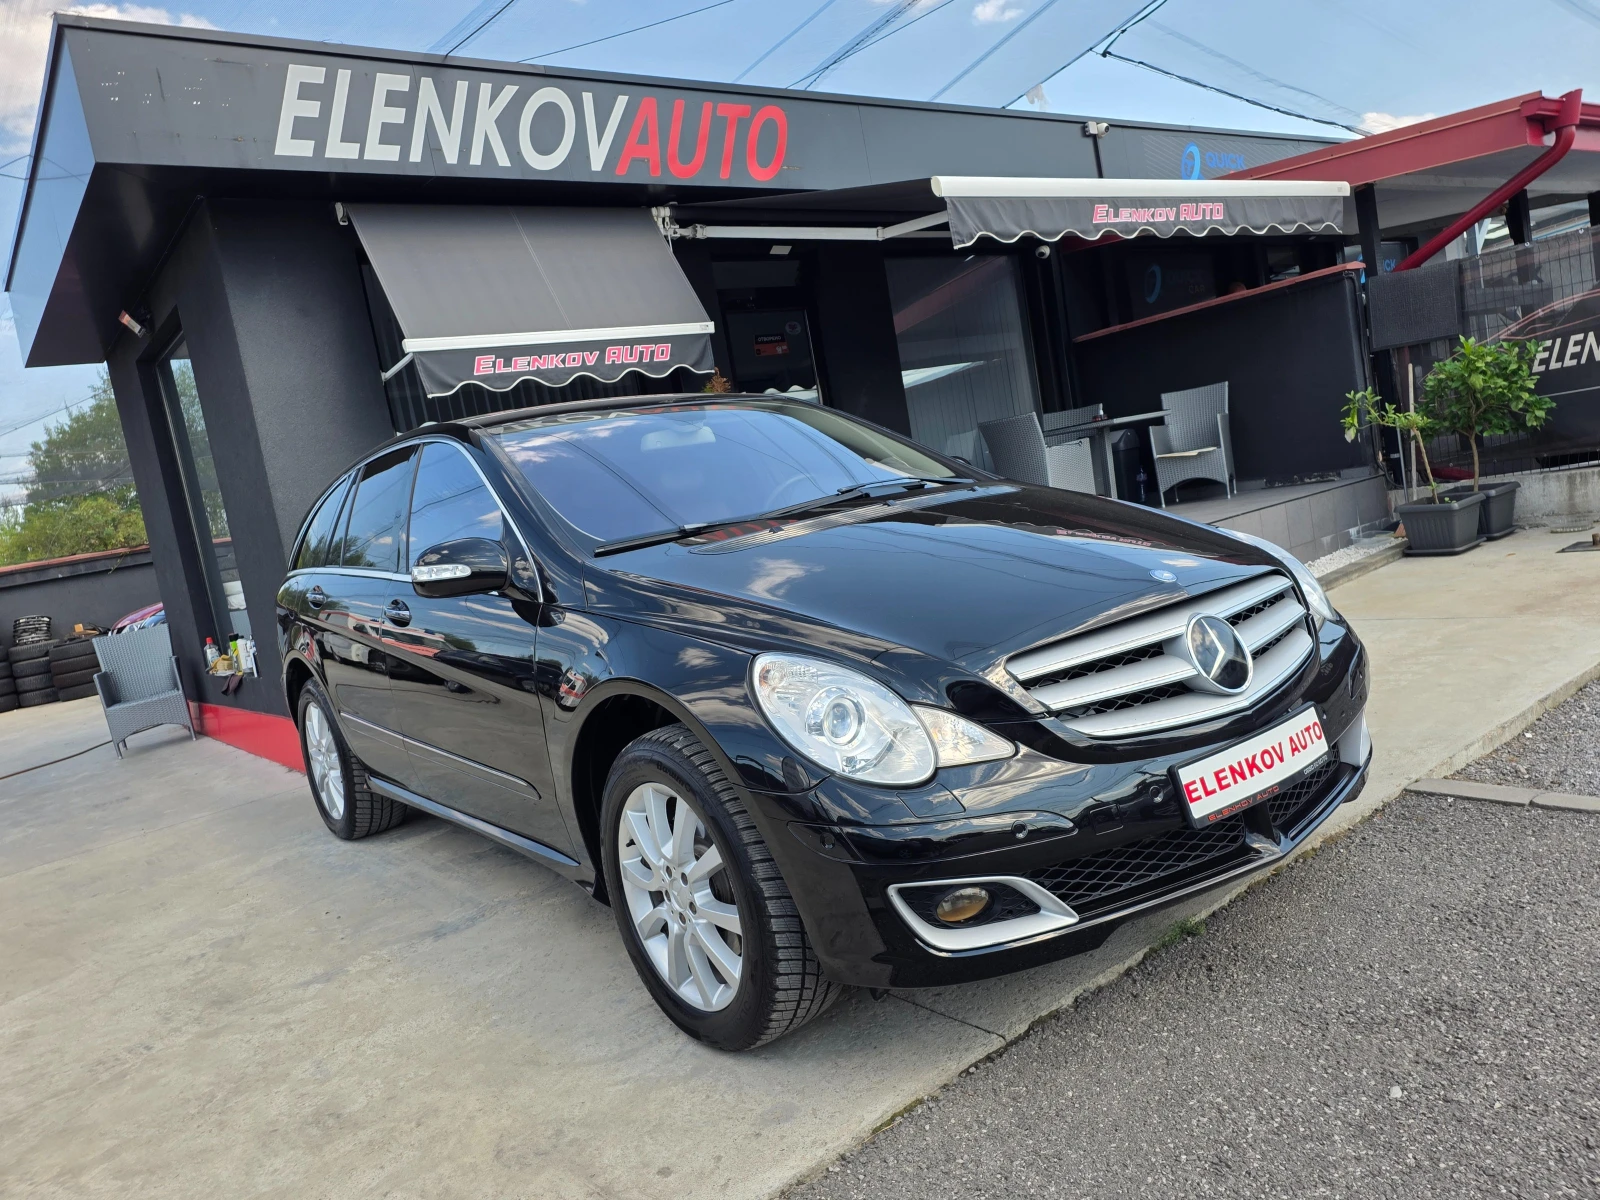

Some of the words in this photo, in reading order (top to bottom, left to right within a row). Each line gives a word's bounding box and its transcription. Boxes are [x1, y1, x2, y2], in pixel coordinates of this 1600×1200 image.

[1205, 151, 1246, 169] QUICK
[1093, 204, 1176, 223] ELENKOV
[1180, 203, 1224, 221] AUTO
[474, 350, 600, 375] ELENKOV
[605, 343, 671, 365] AUTO
[1183, 741, 1285, 804] ELENKOV
[1289, 720, 1323, 758] AUTO
[1256, 784, 1281, 801] AUTO
